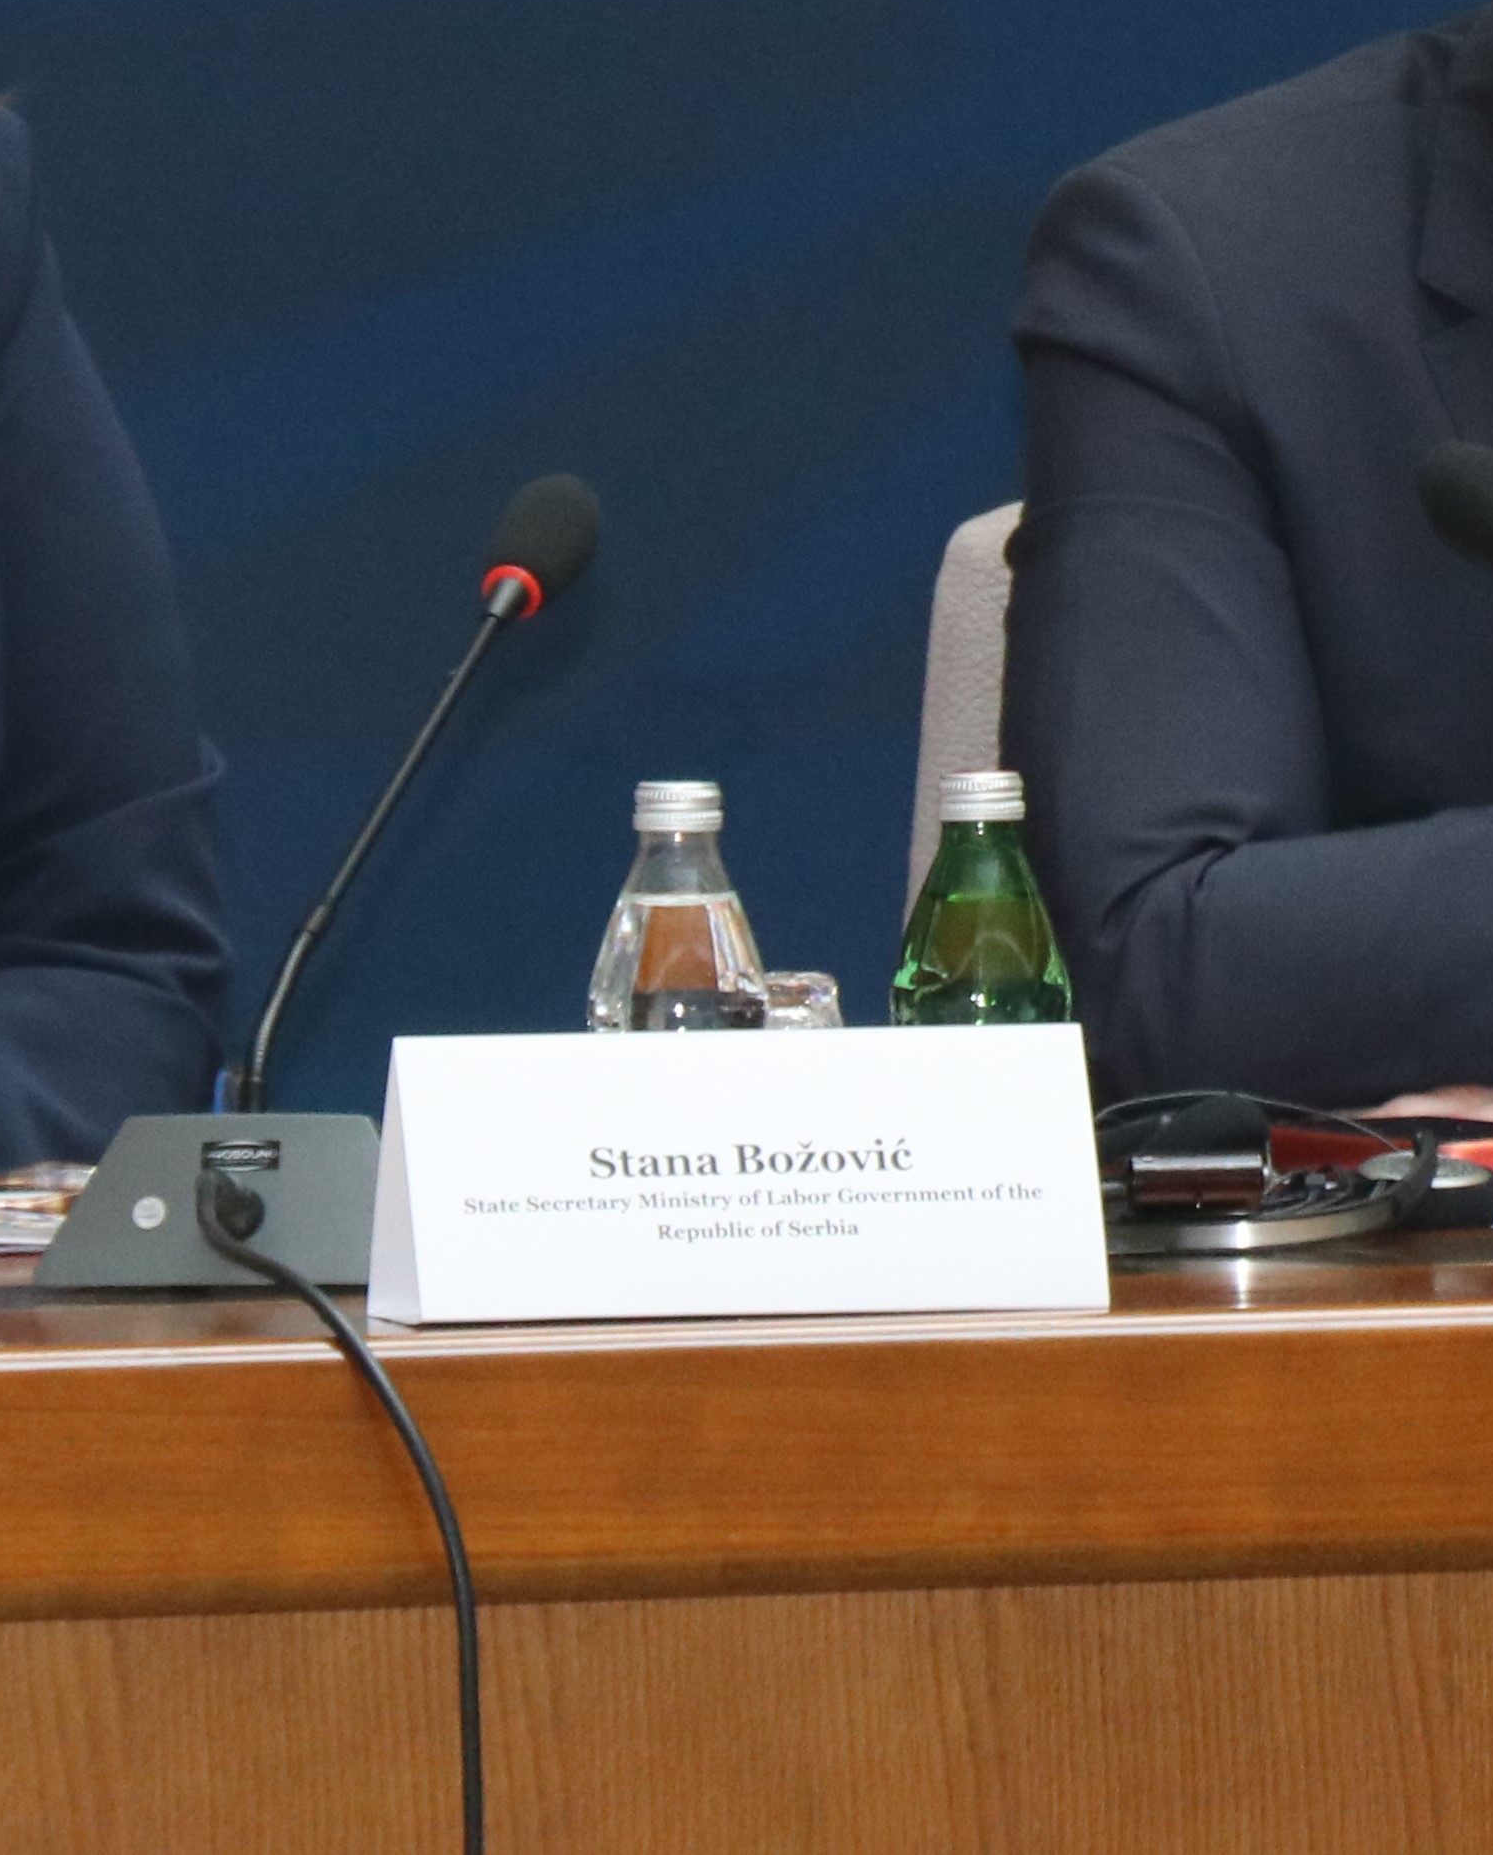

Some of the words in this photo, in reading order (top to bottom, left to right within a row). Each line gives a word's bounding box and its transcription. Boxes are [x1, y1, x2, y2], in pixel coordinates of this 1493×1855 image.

[589, 1147, 720, 1179] Stana
[734, 1138, 913, 1175] Božović
[463, 1198, 520, 1214] State
[526, 1195, 631, 1213] Secretary
[638, 1191, 732, 1211] Ministry
[739, 1189, 761, 1207] of
[766, 1188, 831, 1206] Labor
[837, 1185, 974, 1204] Government
[981, 1183, 1004, 1201] of
[1008, 1182, 1043, 1201] the
[657, 1221, 755, 1243] Republic
[761, 1220, 783, 1237] of
[788, 1219, 860, 1237] Serbia
